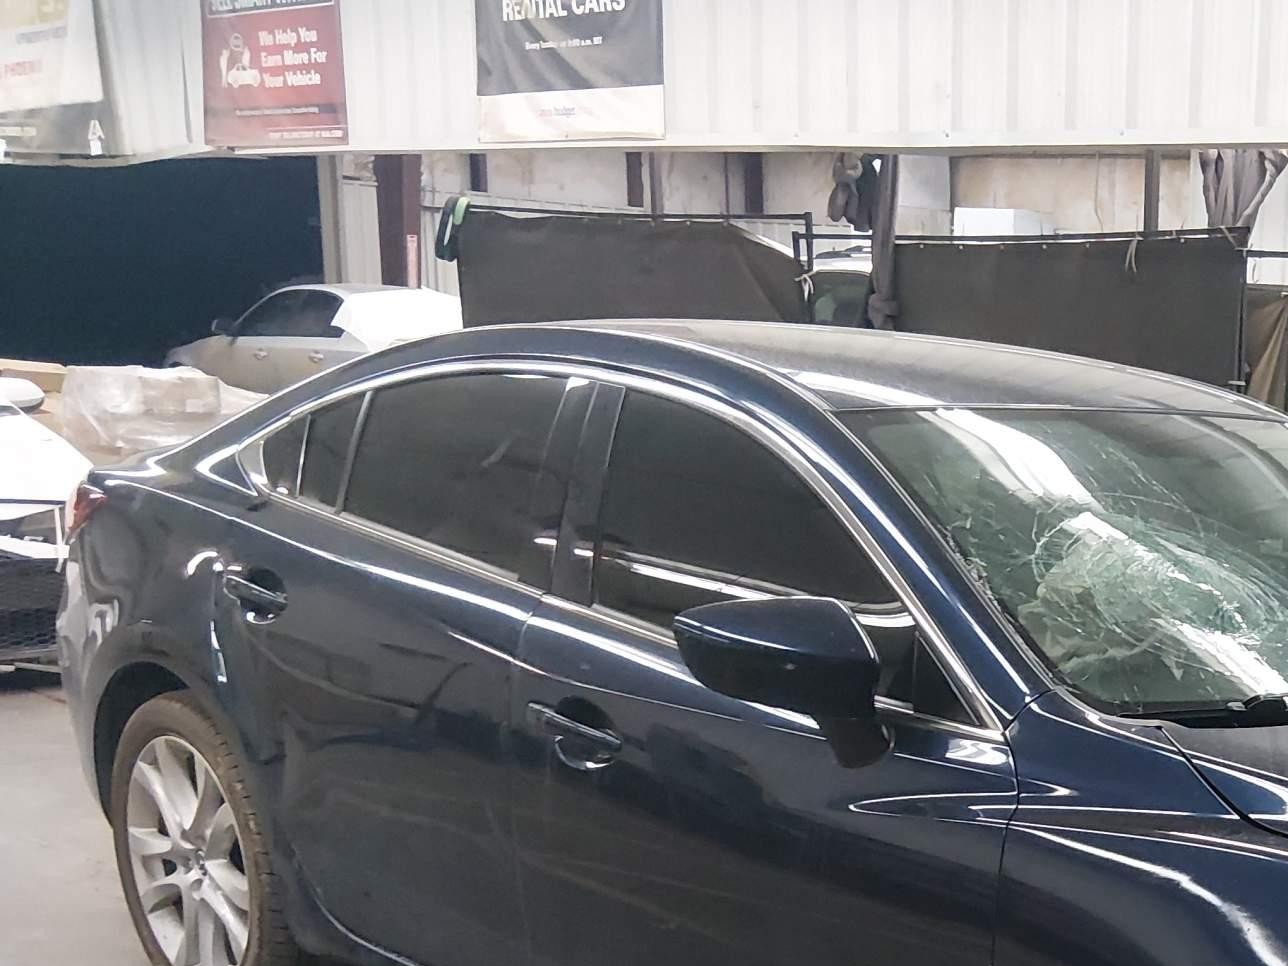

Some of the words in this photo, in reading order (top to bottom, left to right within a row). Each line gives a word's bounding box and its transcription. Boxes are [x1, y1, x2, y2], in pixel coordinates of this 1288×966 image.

[502, 0, 568, 21] RENTAL
[571, 0, 627, 15] CARS
[258, 31, 274, 46] We
[274, 29, 298, 47] Help
[298, 27, 318, 43] You
[260, 52, 283, 67] Earn
[283, 50, 309, 66] More
[310, 48, 328, 63] For
[262, 73, 284, 88] Your
[285, 69, 321, 87] Vehicle
